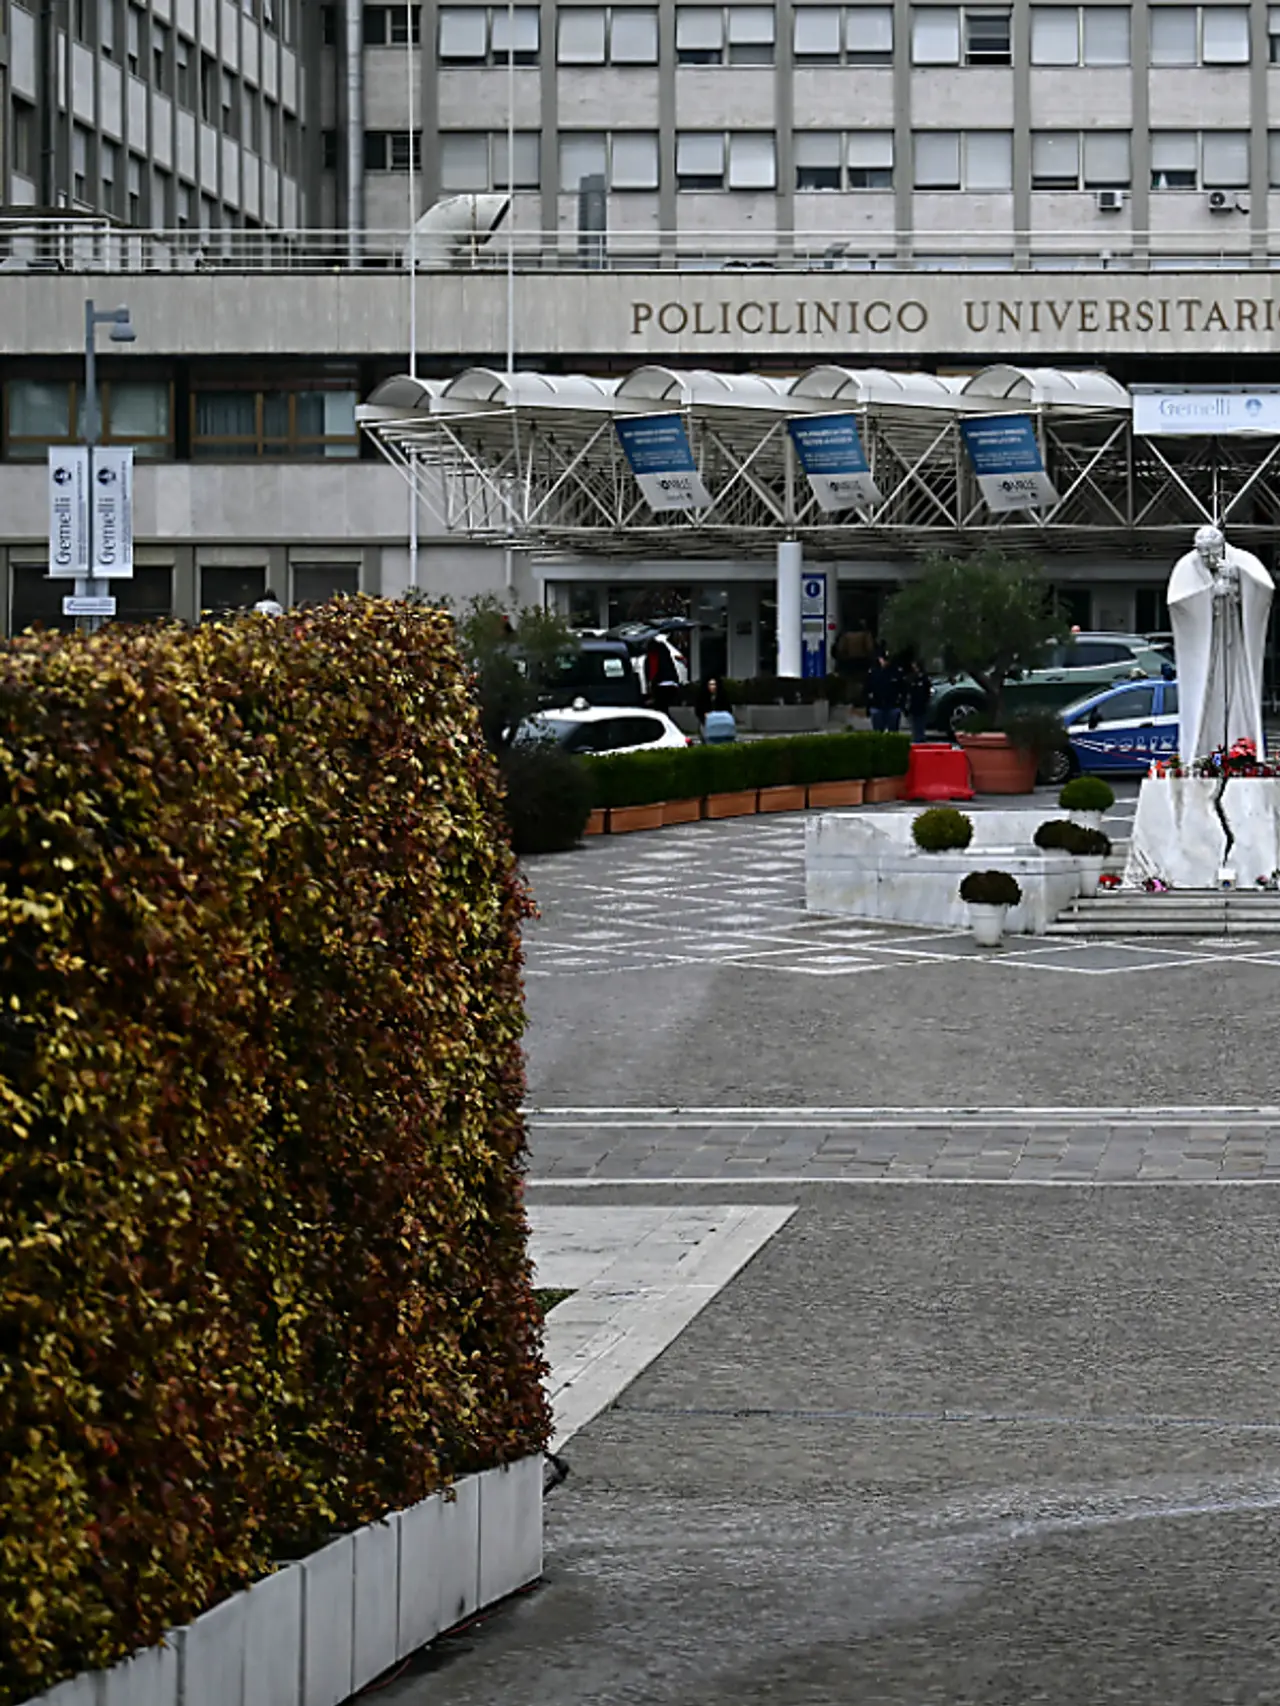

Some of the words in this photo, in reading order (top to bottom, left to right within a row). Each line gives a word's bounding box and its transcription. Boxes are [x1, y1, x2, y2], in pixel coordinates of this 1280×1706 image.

[631, 300, 928, 335] POLICLINICO
[1159, 397, 1231, 418] Gemelli
[54, 496, 72, 566] Gemelli
[97, 496, 116, 566] Gemelli
